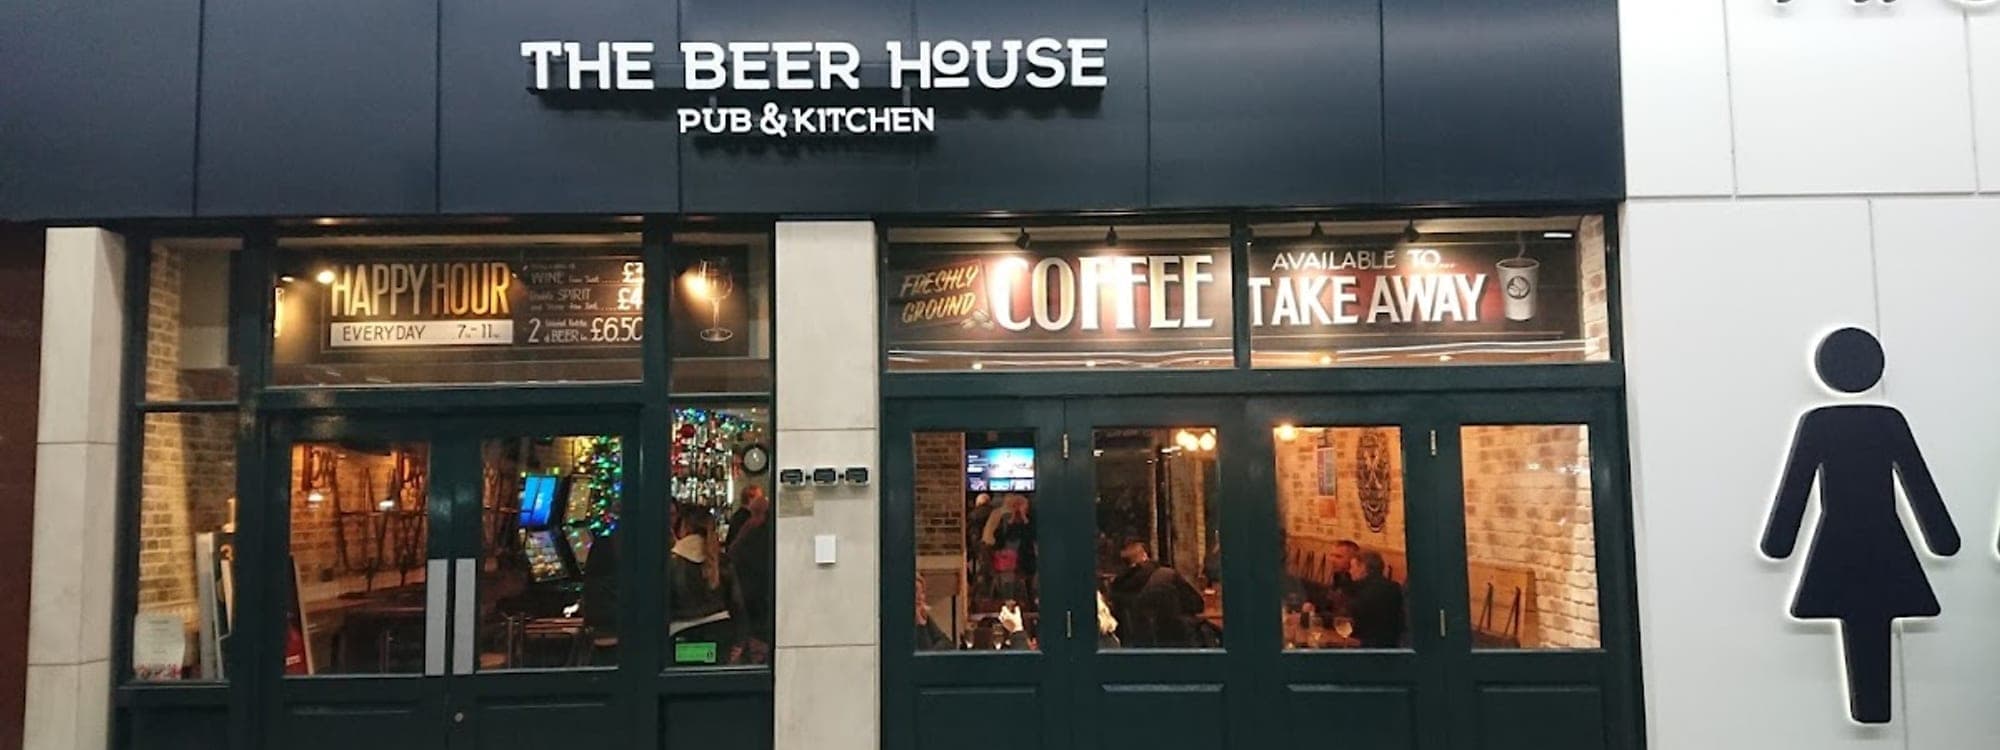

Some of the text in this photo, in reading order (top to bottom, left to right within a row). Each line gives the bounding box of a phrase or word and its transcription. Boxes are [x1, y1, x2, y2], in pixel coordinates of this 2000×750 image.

[520, 37, 1108, 90] THE BEER HOUSE
[677, 102, 934, 137] PUB & KITCHEN
[1272, 250, 1397, 271] AVAILABLE
[331, 262, 510, 316] HAPPY HOUR
[558, 288, 591, 302] SPIRIT
[899, 264, 979, 298] FRESHLY
[991, 255, 1214, 331] COFFEE
[902, 292, 976, 324] GROUND
[1248, 272, 1486, 326] TAKE AWAY
[528, 317, 643, 343] 2 £6.50
[551, 328, 579, 343] BEER
